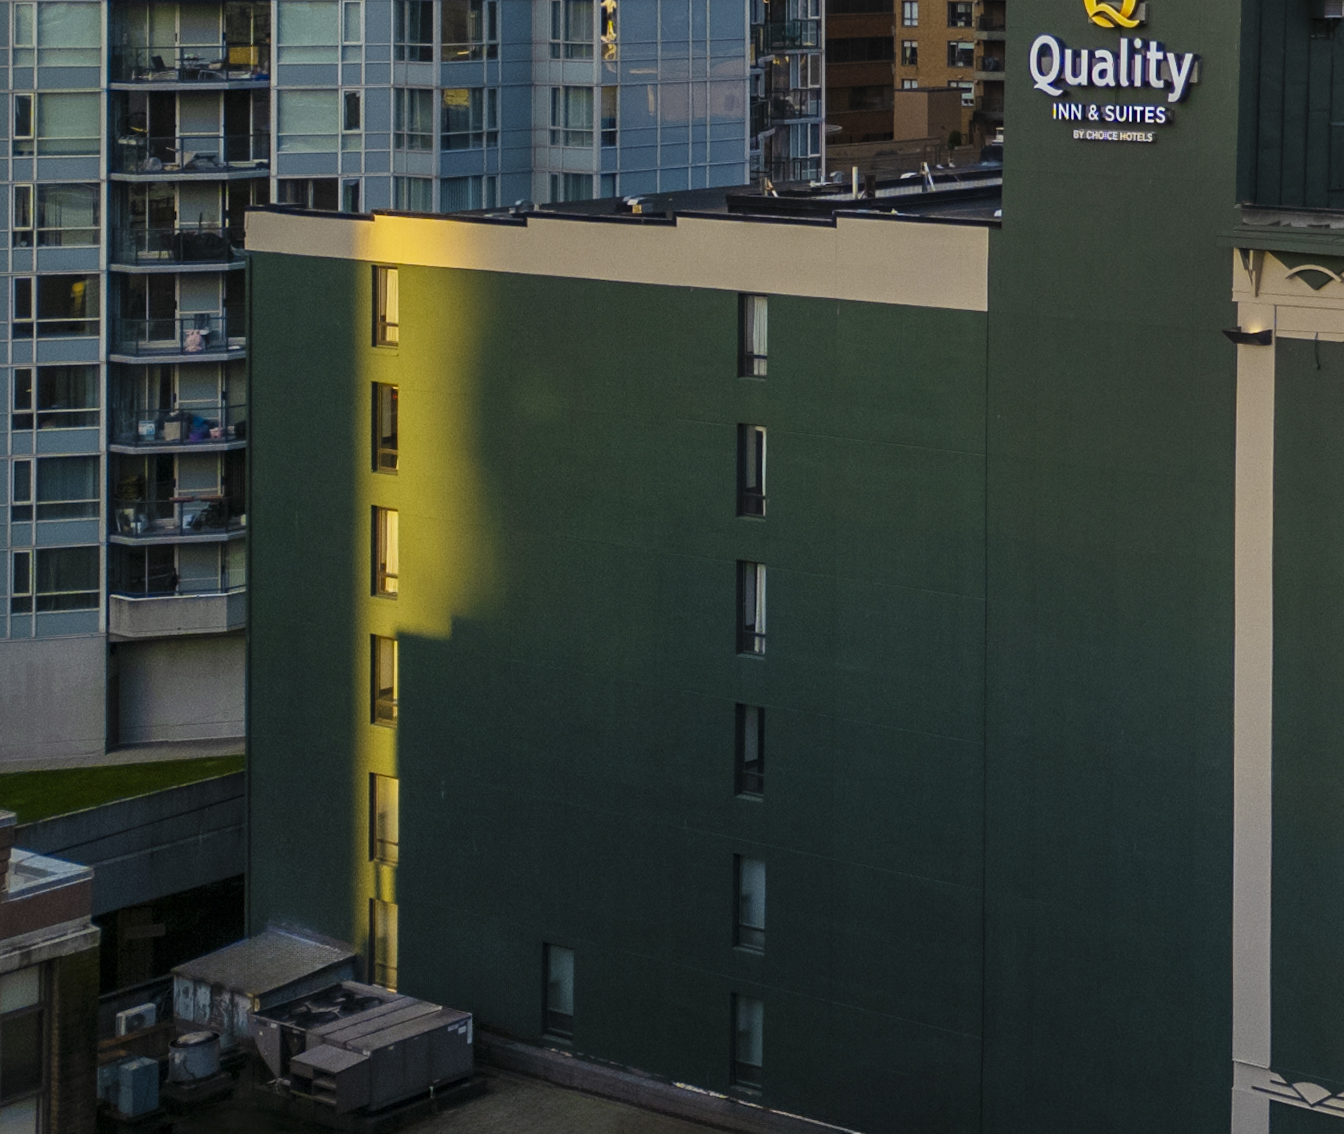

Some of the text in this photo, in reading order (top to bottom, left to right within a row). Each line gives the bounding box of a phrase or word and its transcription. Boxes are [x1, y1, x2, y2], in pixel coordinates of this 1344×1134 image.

[1029, 34, 1194, 102] Quality
[1053, 103, 1166, 124] INN & SUITES
[1073, 129, 1153, 143] BY CHOICE HOTELS
